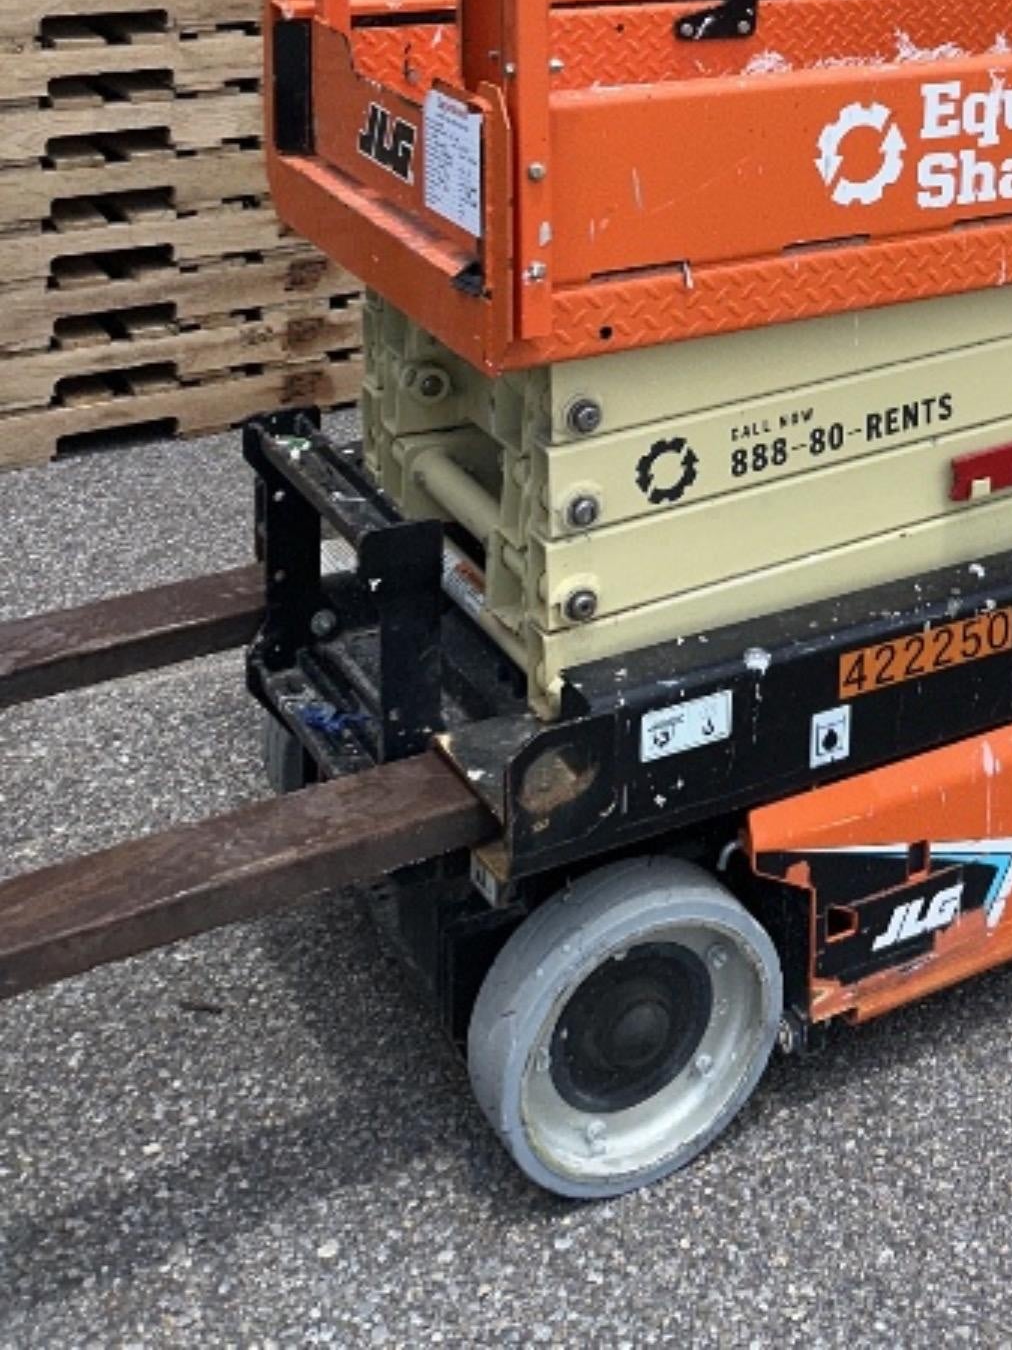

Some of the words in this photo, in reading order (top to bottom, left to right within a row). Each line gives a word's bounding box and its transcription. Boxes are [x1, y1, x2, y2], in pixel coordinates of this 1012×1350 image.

[357, 101, 418, 186] JLG
[730, 392, 953, 478] 888-80-RENTS
[842, 611, 1009, 691] 422250
[871, 882, 964, 952] JLG
